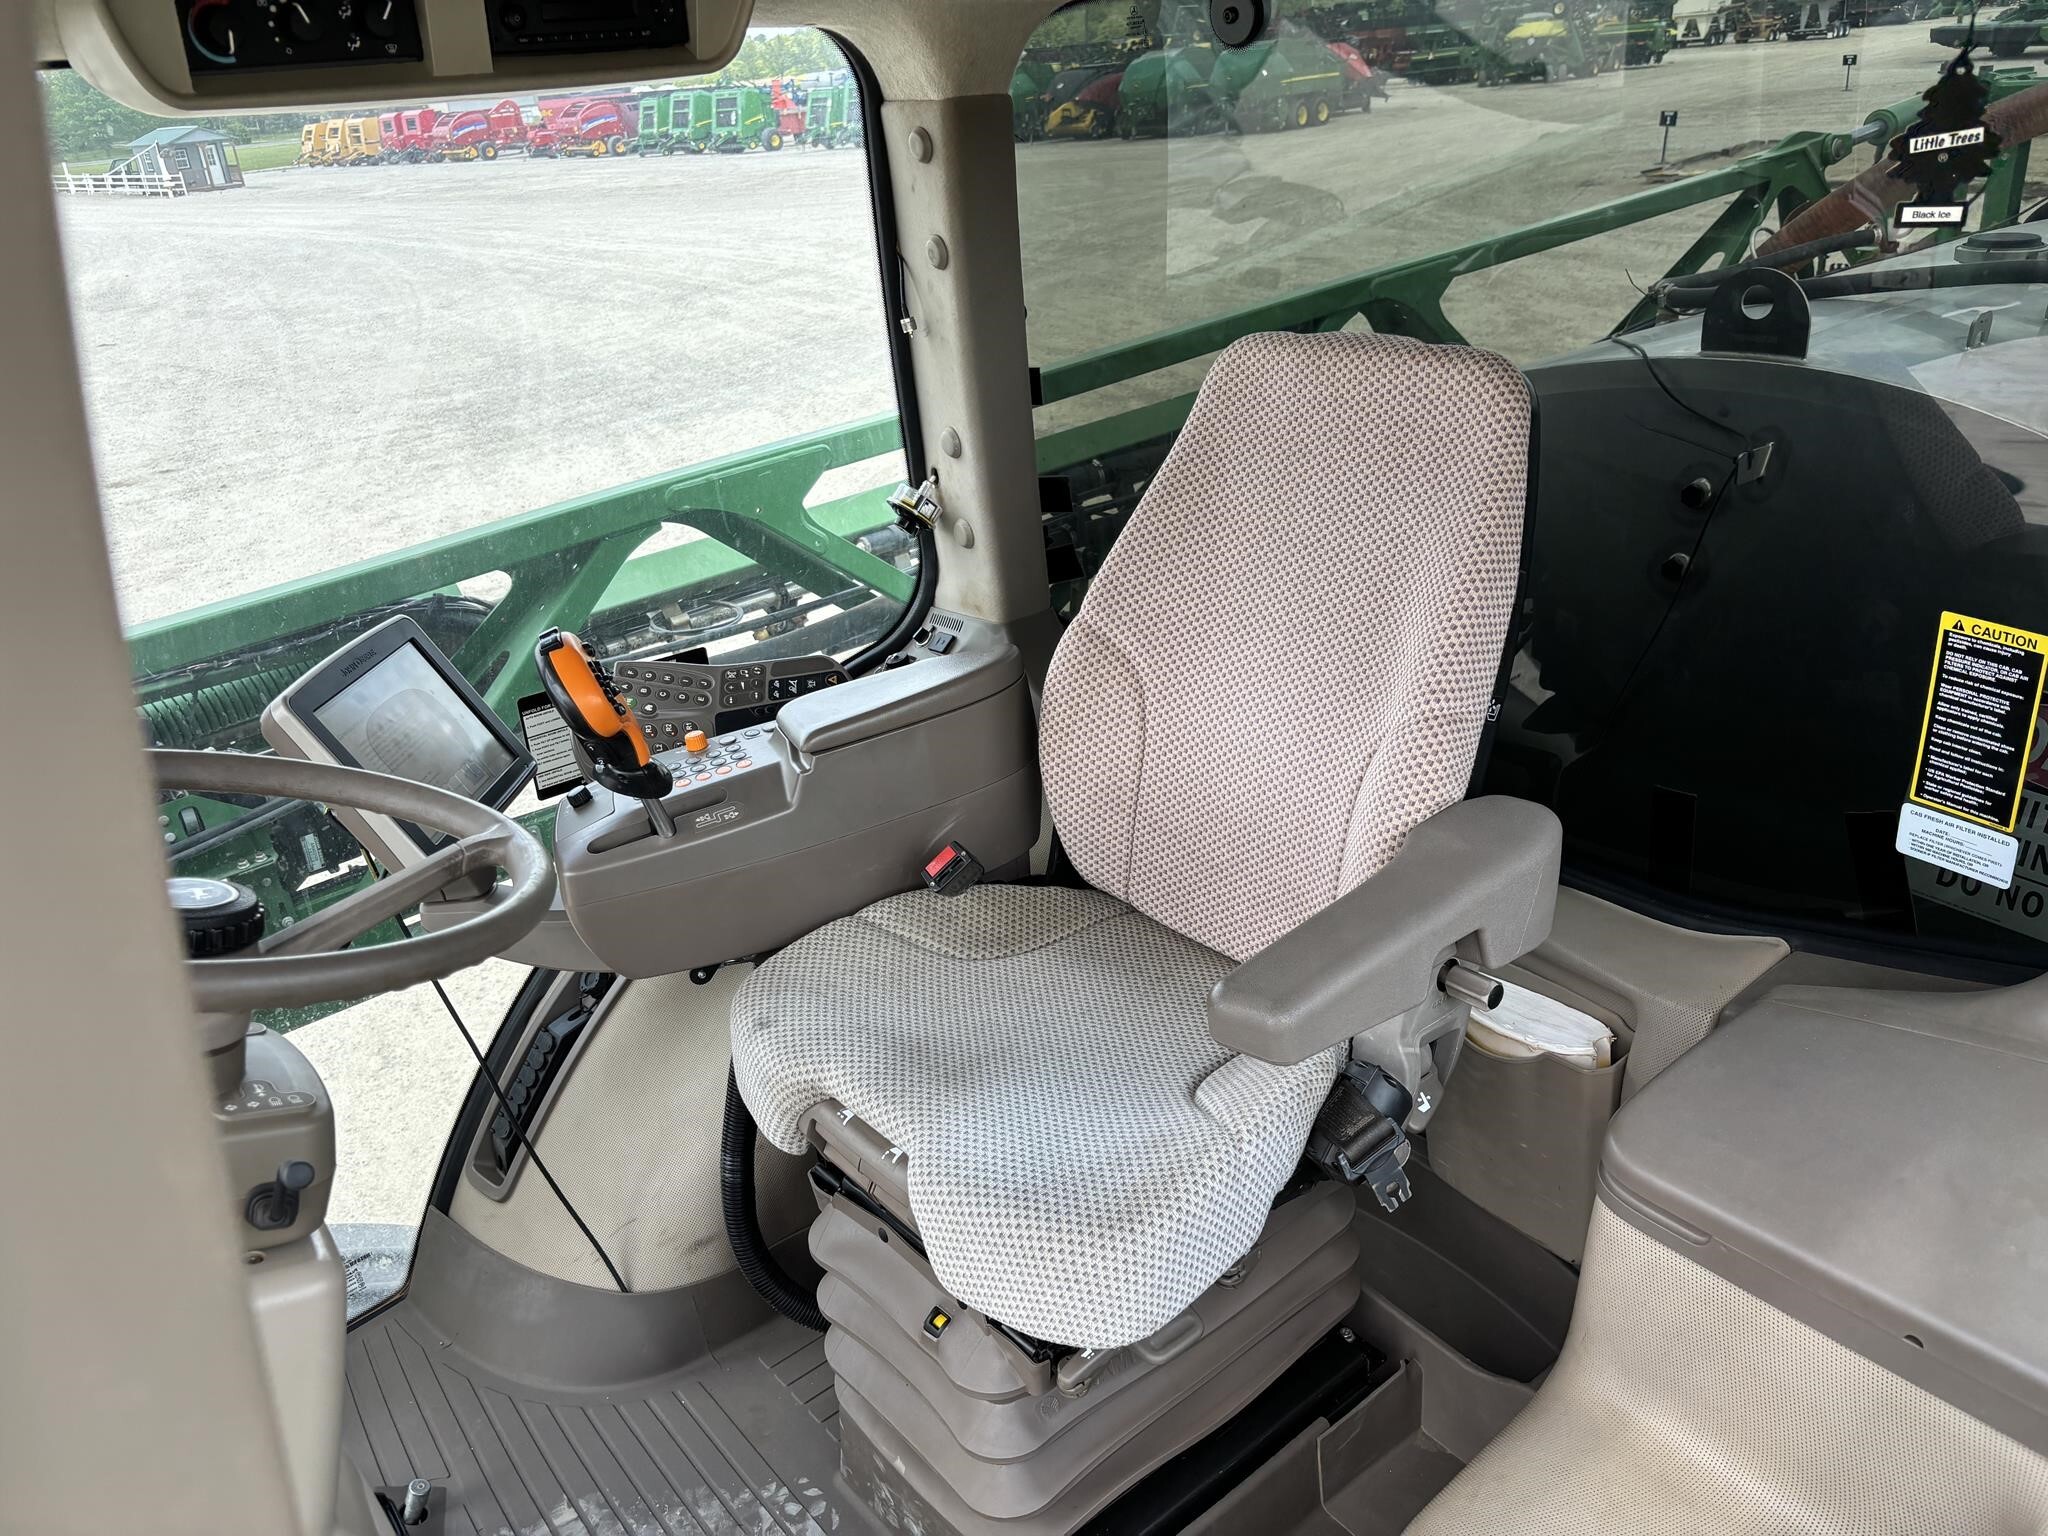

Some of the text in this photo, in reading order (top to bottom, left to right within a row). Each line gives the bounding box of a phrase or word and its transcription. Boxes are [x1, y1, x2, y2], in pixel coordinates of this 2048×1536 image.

[1914, 133, 1981, 151] Little Trees
[1912, 211, 1936, 219] Black
[1971, 624, 2038, 650] CAUTION
[1910, 808, 1922, 818] CAB
[1924, 813, 1944, 825] FRESH
[1944, 820, 1955, 829] AIR
[1955, 824, 1976, 836] FILTER
[1977, 831, 2010, 848] INSTALLED
[1921, 829, 1944, 840] MACHINE
